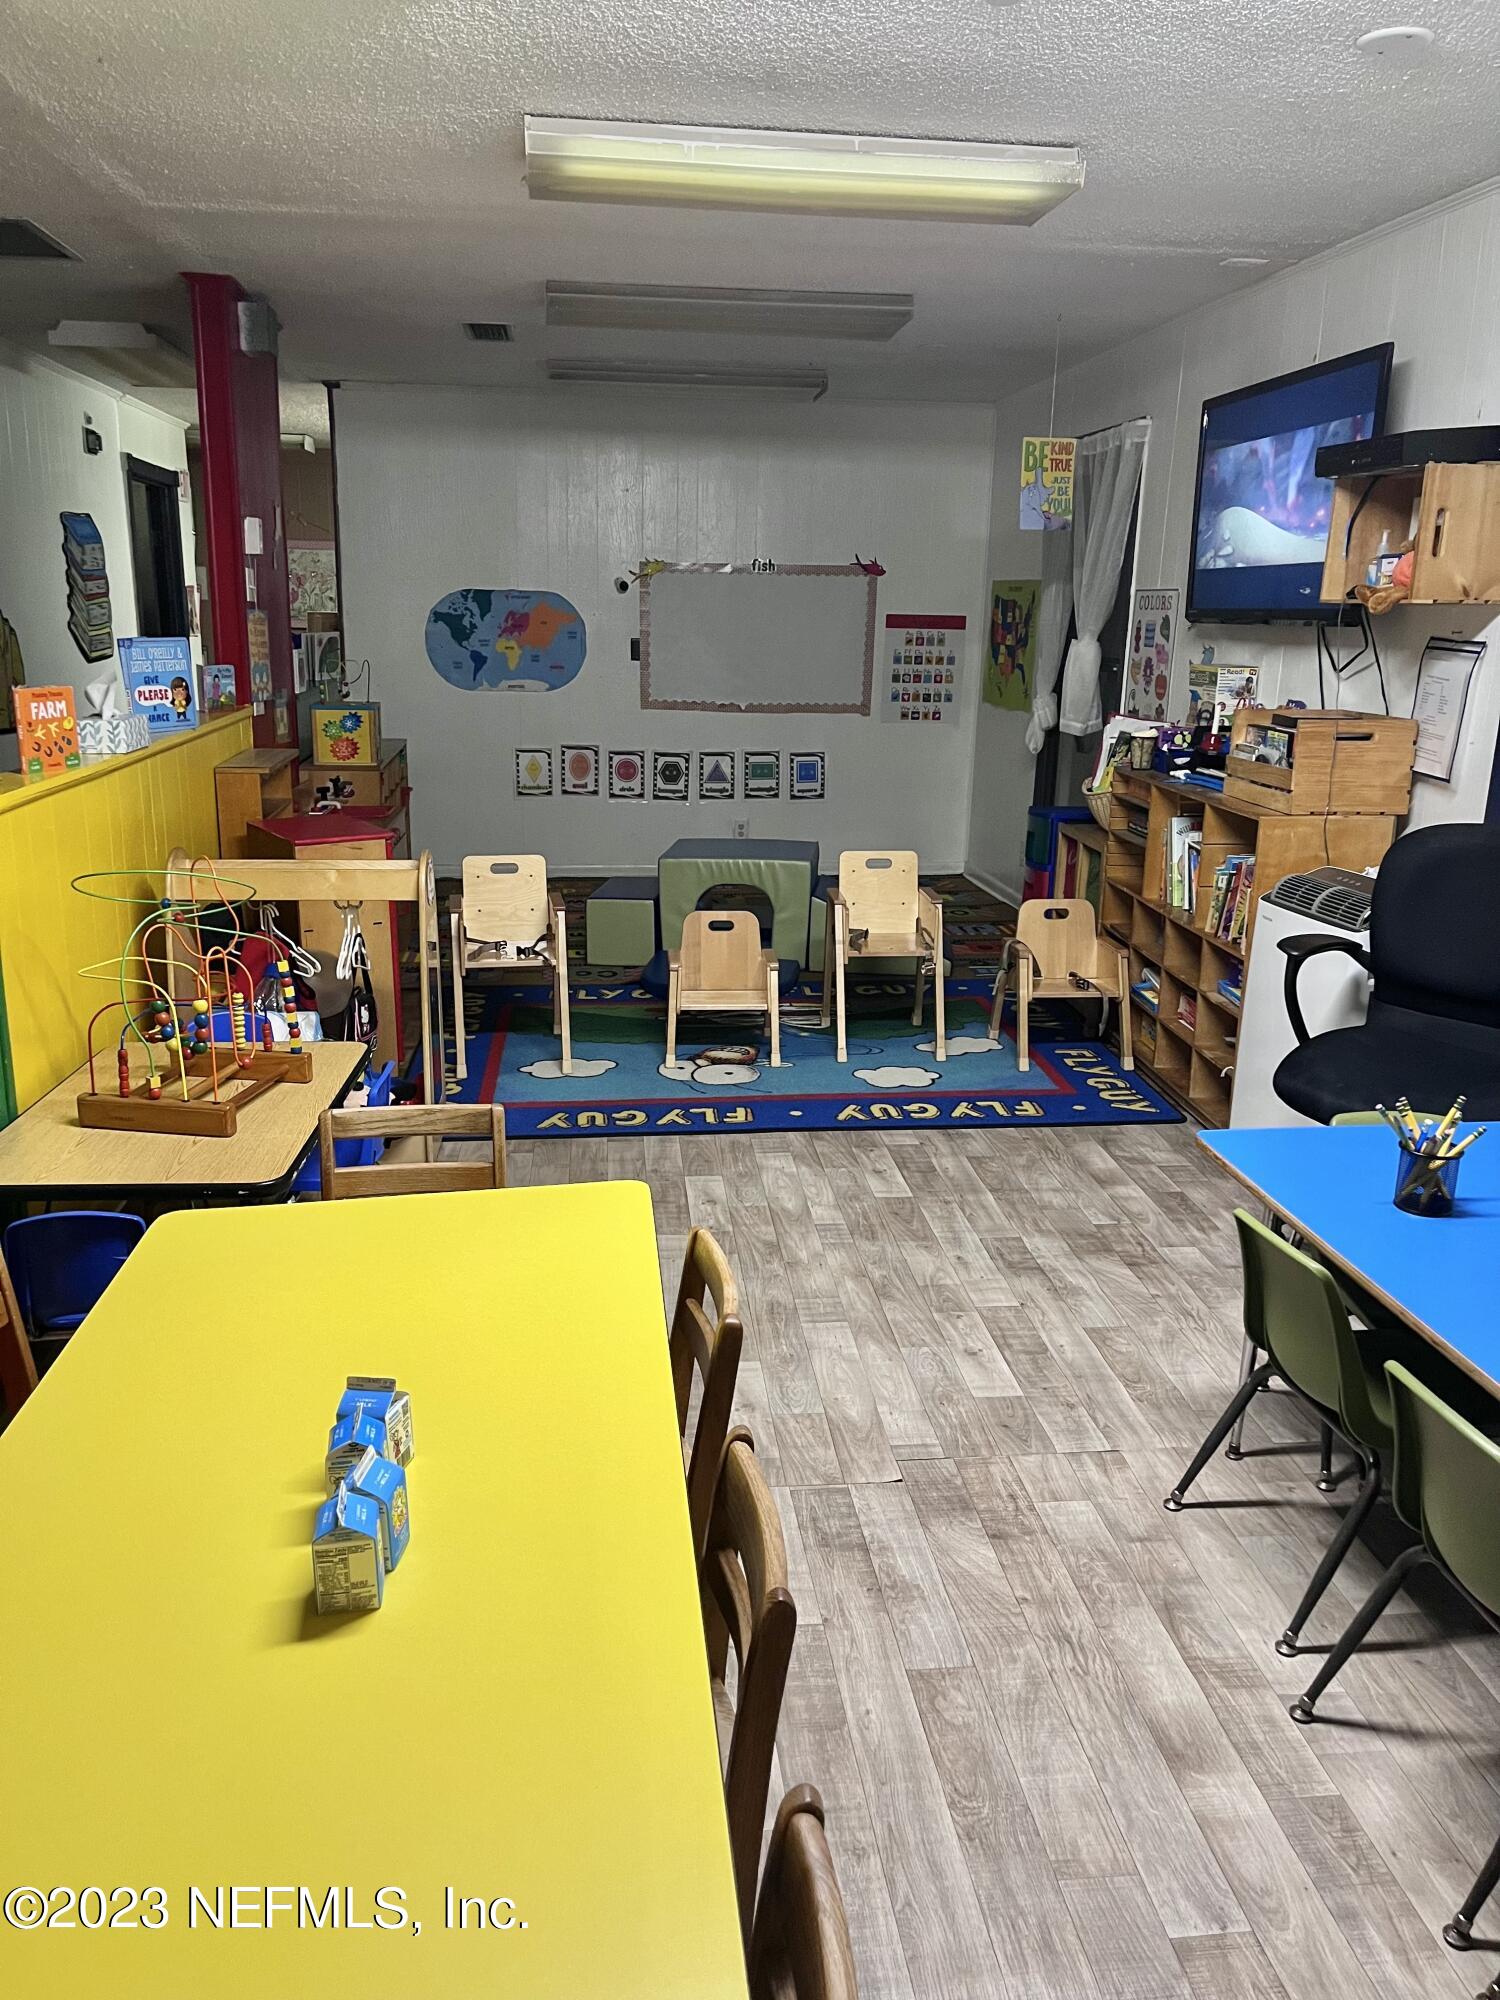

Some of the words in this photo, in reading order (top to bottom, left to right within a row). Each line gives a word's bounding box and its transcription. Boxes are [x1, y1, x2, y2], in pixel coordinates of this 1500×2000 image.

[1050, 441, 1074, 456] KIND
[1024, 441, 1049, 472] BE
[1049, 458, 1072, 473] TRUE
[1052, 476, 1071, 485] JUST
[1056, 486, 1069, 497] BE
[751, 558, 776, 572] fish
[1138, 595, 1173, 610] COLORS
[131, 647, 147, 660] BILL
[143, 676, 160, 686] GIVE
[137, 689, 169, 702] PLEASE
[30, 700, 68, 720] FARM
[1054, 1048, 1118, 1075] FLY
[1086, 1077, 1160, 1112] GUY
[655, 1107, 754, 1126] FLY
[836, 1104, 940, 1122] GUY
[951, 1101, 1045, 1118] FLY
[536, 1111, 648, 1129] GUY
